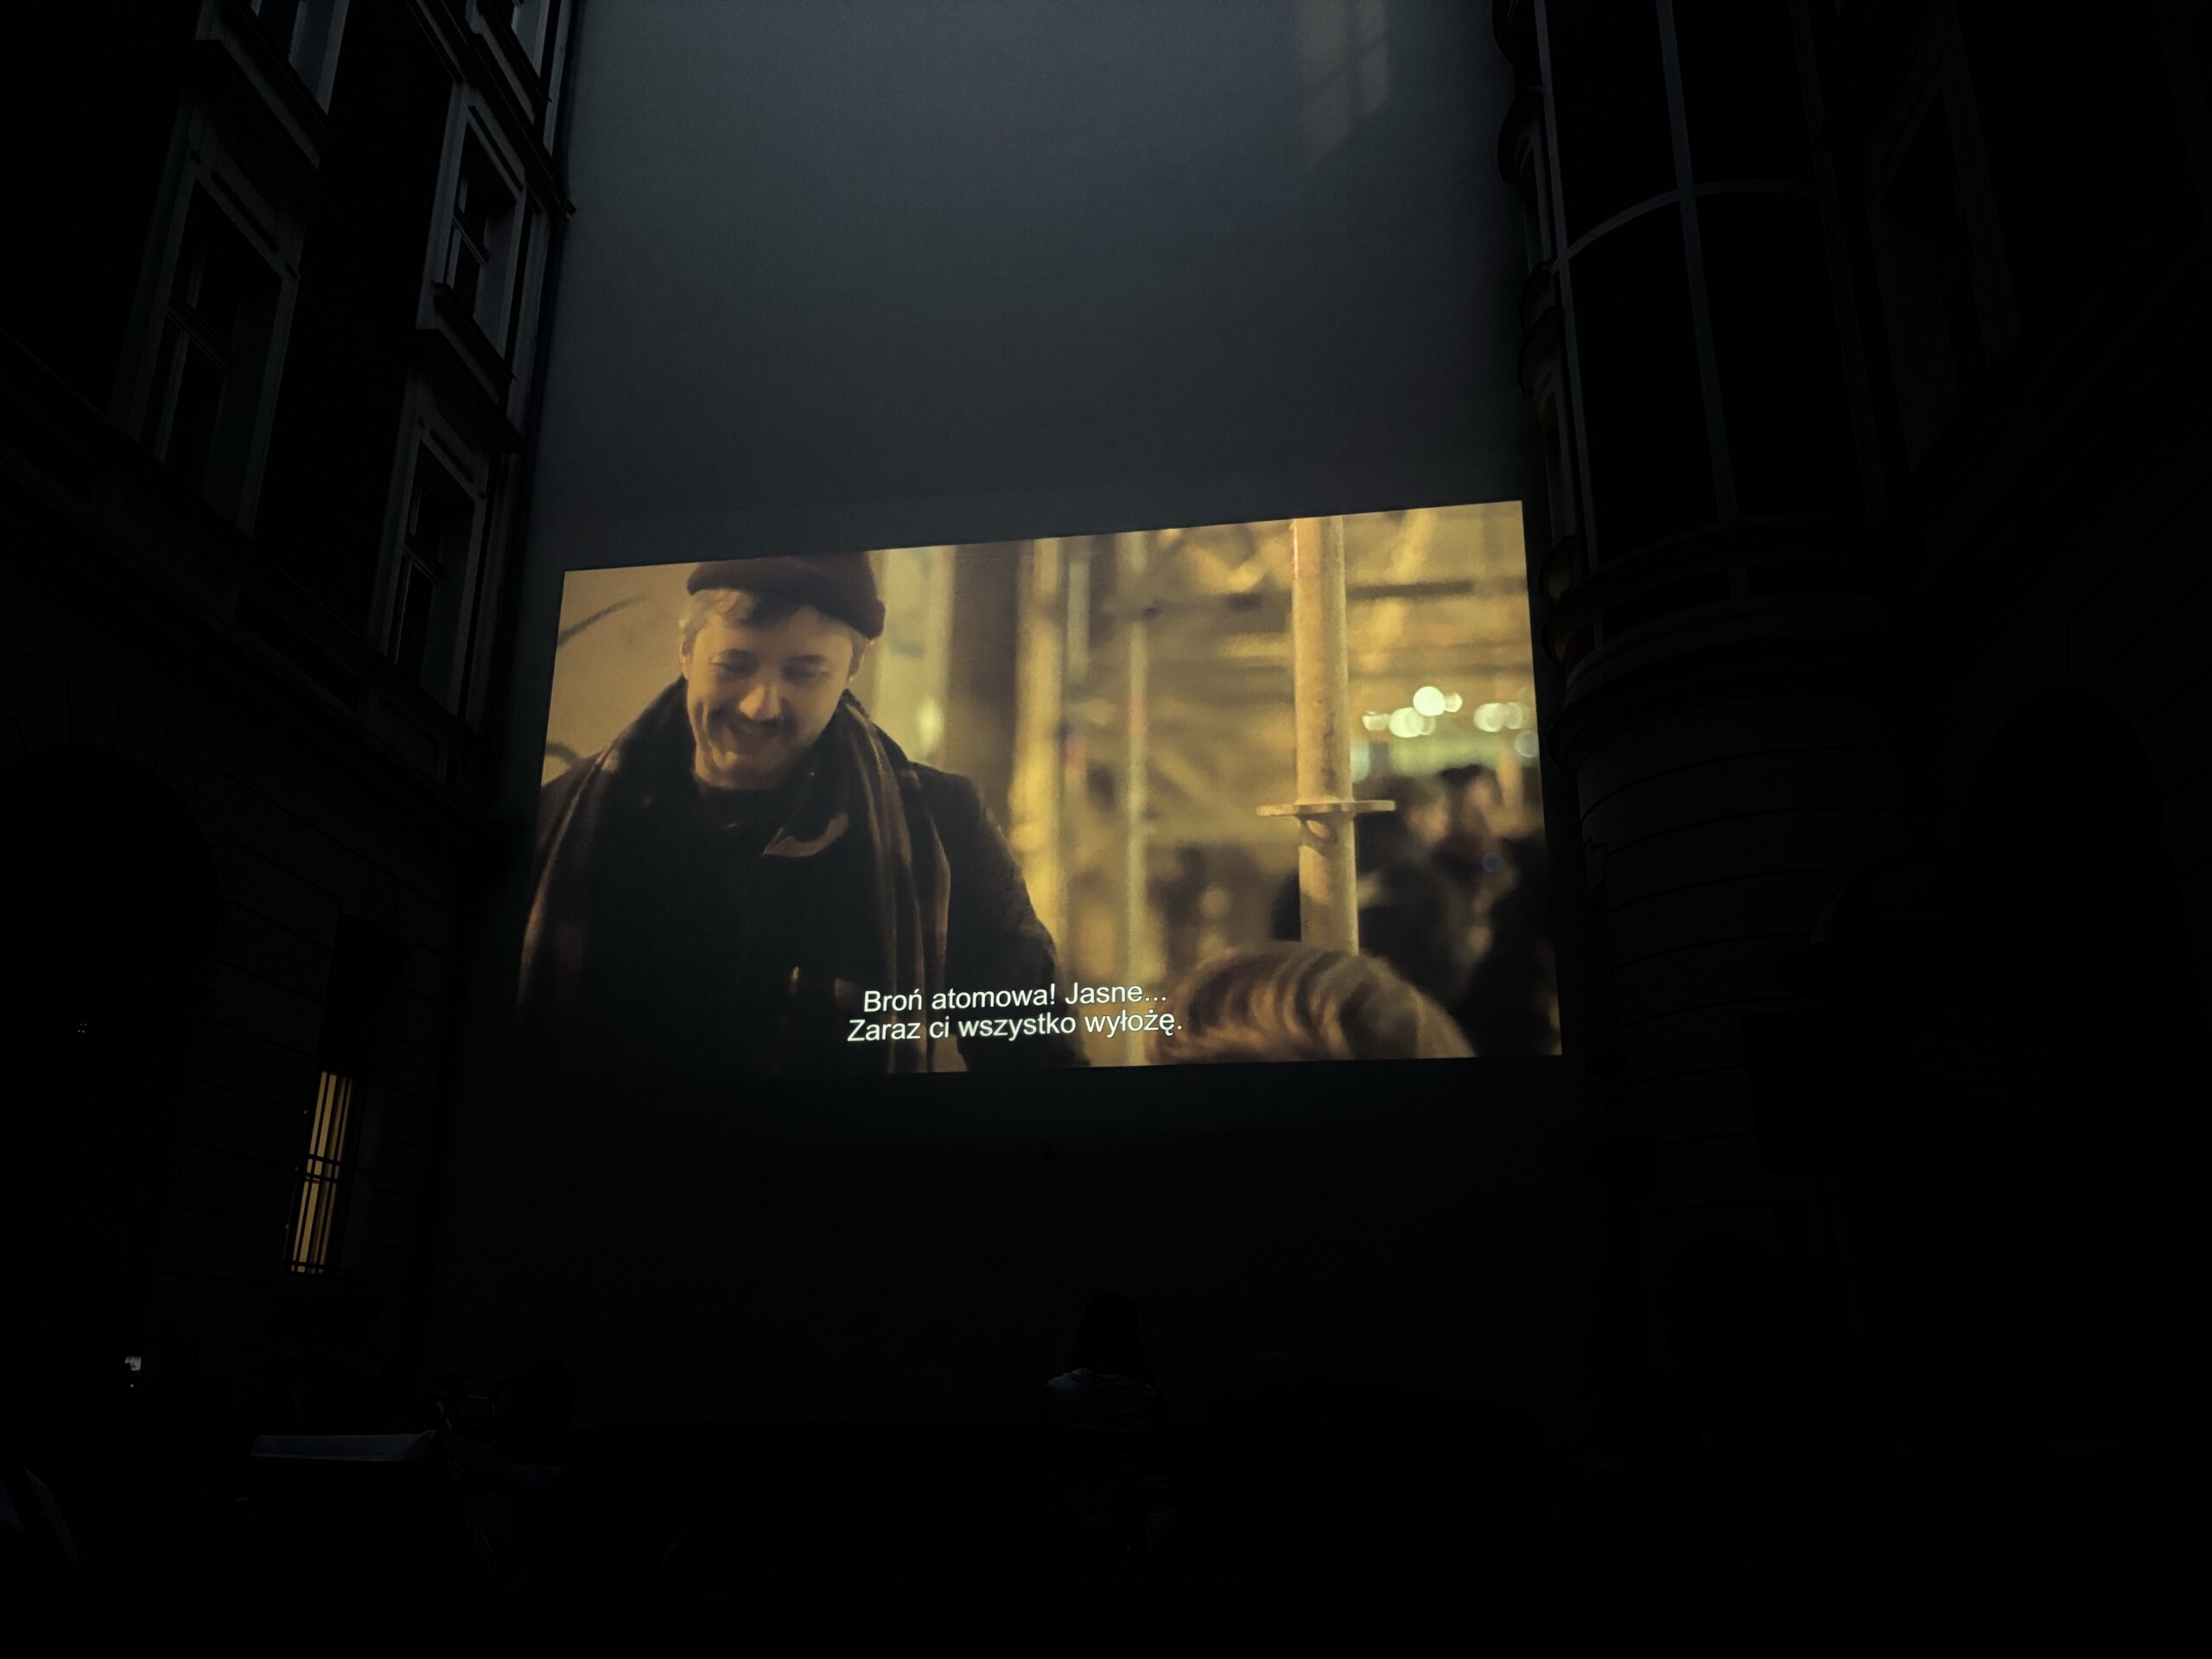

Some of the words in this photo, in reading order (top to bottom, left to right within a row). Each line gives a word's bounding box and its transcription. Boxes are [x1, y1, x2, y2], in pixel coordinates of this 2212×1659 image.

[863, 988, 923, 1013] Broń
[931, 983, 1056, 1010] atomowa!
[1065, 982, 1168, 1005] Jasne...
[847, 1019, 921, 1042] Zaraz
[929, 1016, 950, 1039] ci
[957, 1012, 1077, 1041] wszystko
[1084, 1009, 1184, 1037] wyłożę.
